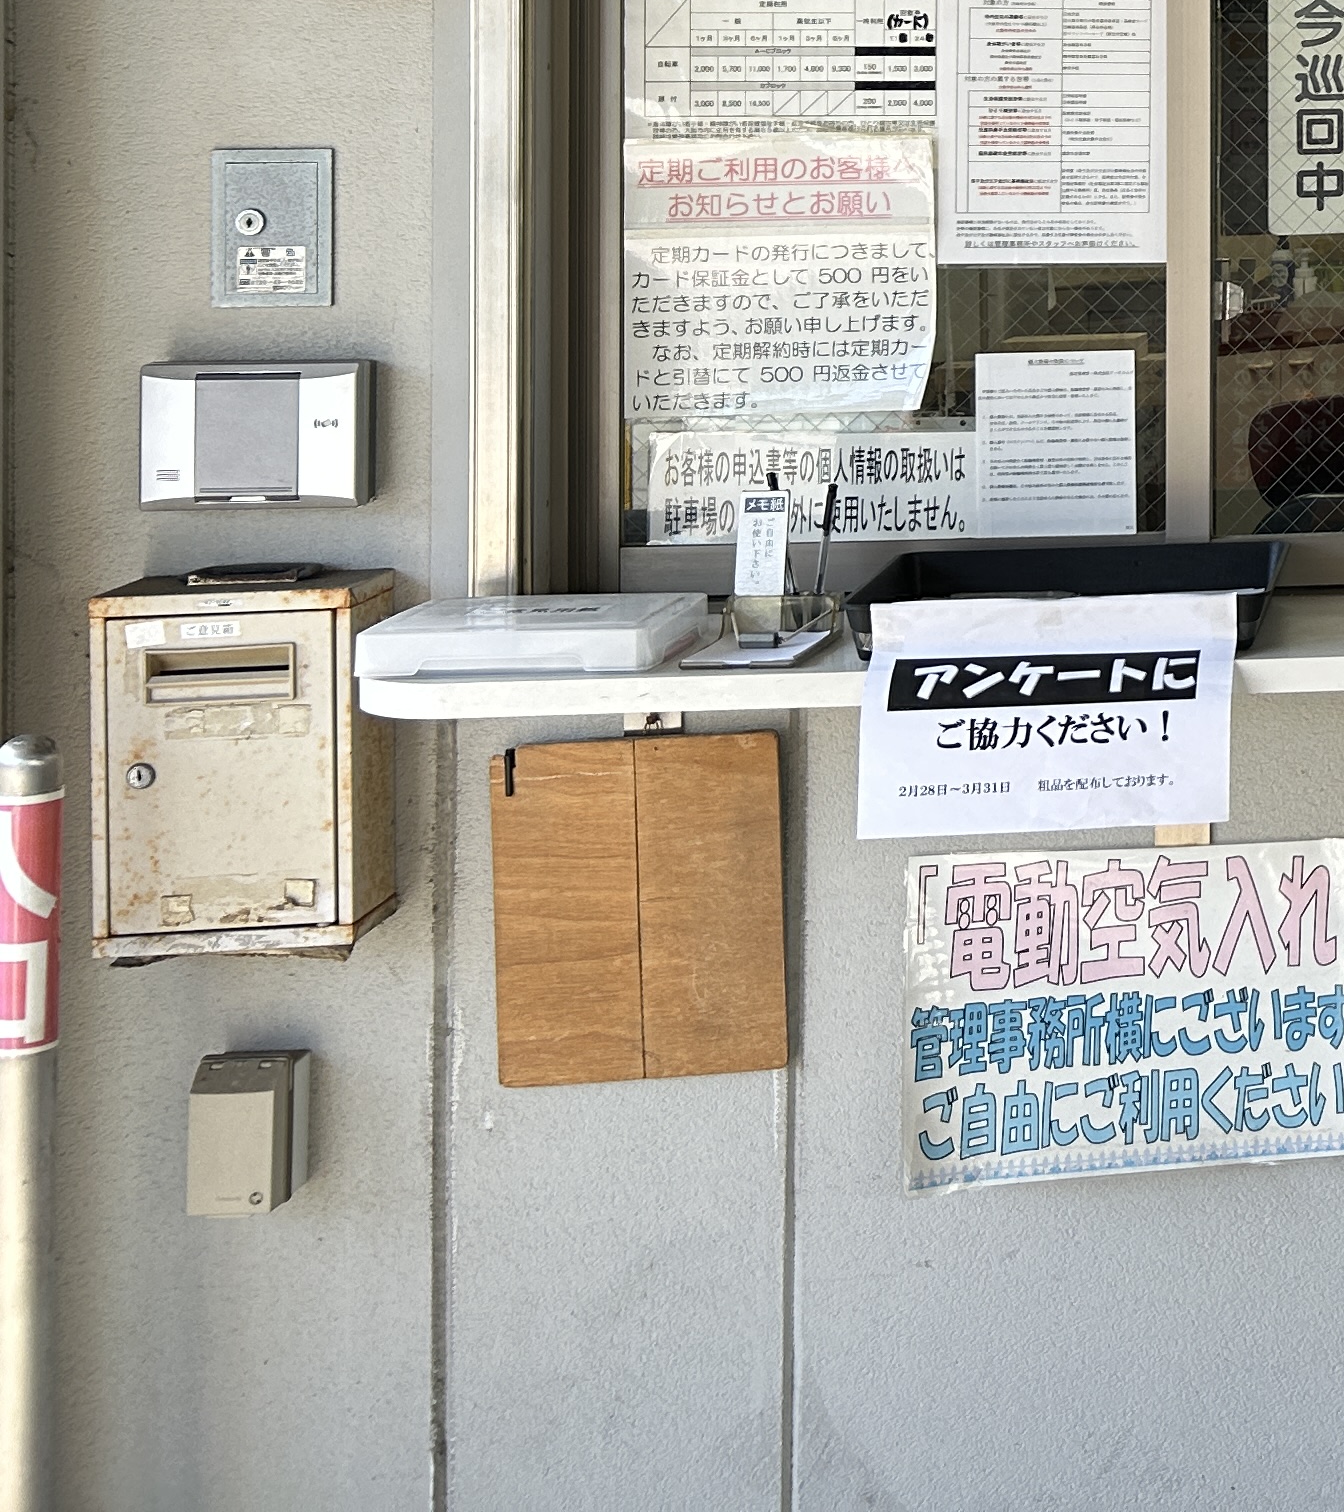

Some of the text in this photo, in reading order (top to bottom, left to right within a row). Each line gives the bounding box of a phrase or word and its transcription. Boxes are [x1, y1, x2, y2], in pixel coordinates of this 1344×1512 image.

[668, 190, 892, 218] お知らせとお願い
[651, 241, 936, 265] 定期カードの発行につきまして、
[632, 265, 929, 289] カード保証金として 500 円をい
[631, 289, 929, 314] ただきますので、ご了承をいただ
[632, 315, 927, 339] きますよう、お願い申し上げます。
[652, 340, 928, 362] なお、定期解約時には定期カー
[634, 363, 925, 387] ドと引替にて 500 円返金させて
[633, 390, 759, 411] いただきます。
[664, 446, 967, 487] お客様の申込書等の個人情報の取扱いは
[745, 497, 785, 512] メモ紙
[914, 656, 1198, 701] アンケートに
[936, 710, 1172, 752] ご協力ください！
[1038, 773, 1175, 793] 粗品を配布しております。
